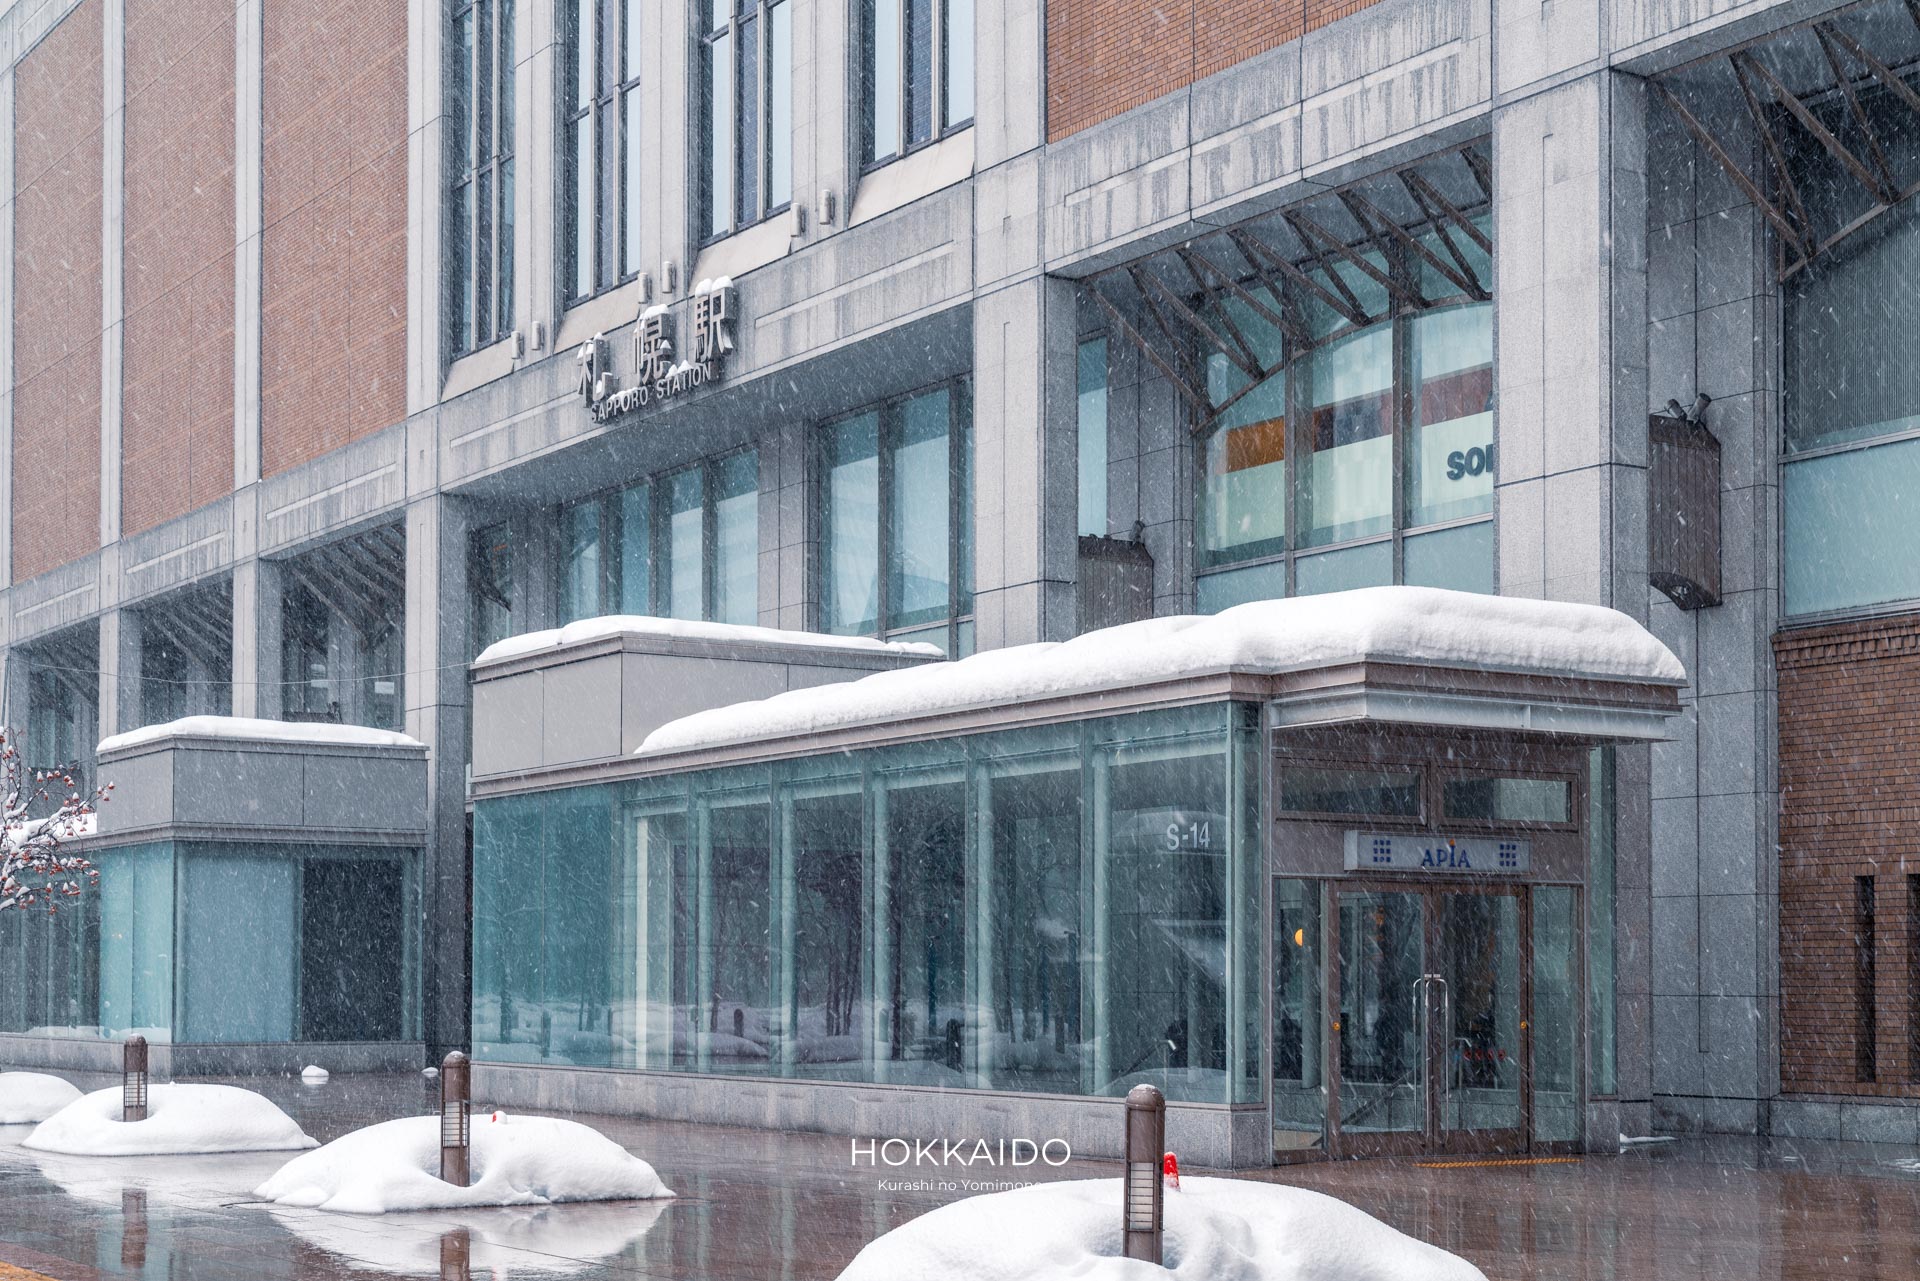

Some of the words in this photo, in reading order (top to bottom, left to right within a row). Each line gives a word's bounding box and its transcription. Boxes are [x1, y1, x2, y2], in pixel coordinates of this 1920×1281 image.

[577, 283, 734, 407] 札幌駅
[591, 386, 649, 422] SAPPORO
[656, 364, 711, 399] STATION
[1166, 821, 1210, 851] S-14
[1420, 839, 1471, 868] APIA
